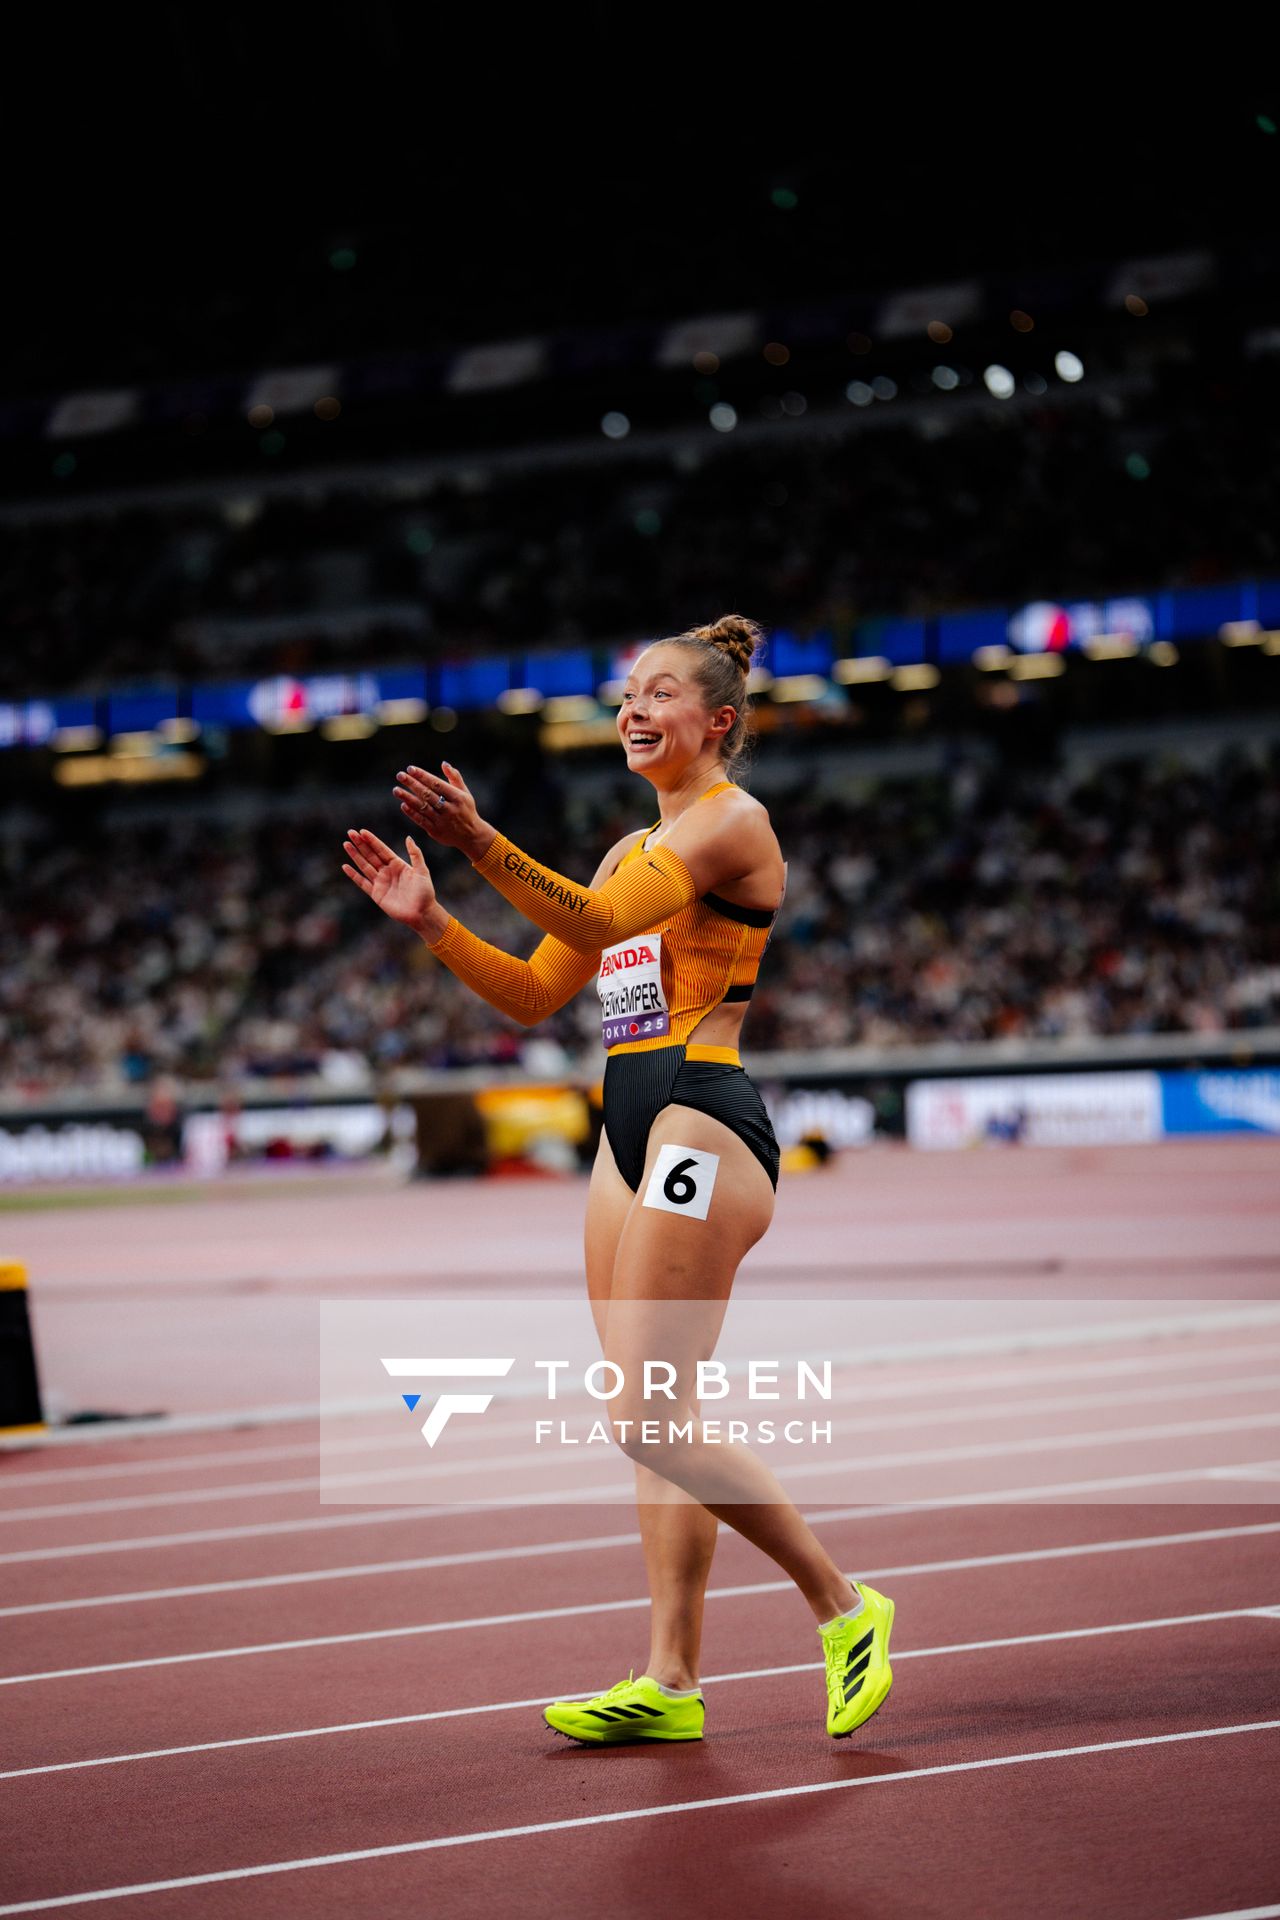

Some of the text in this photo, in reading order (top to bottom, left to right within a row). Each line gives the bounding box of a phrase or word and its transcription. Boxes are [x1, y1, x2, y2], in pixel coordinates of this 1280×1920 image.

[503, 852, 589, 914] GERMANY
[600, 945, 657, 978] HONDA
[663, 1158, 699, 1205] 6
